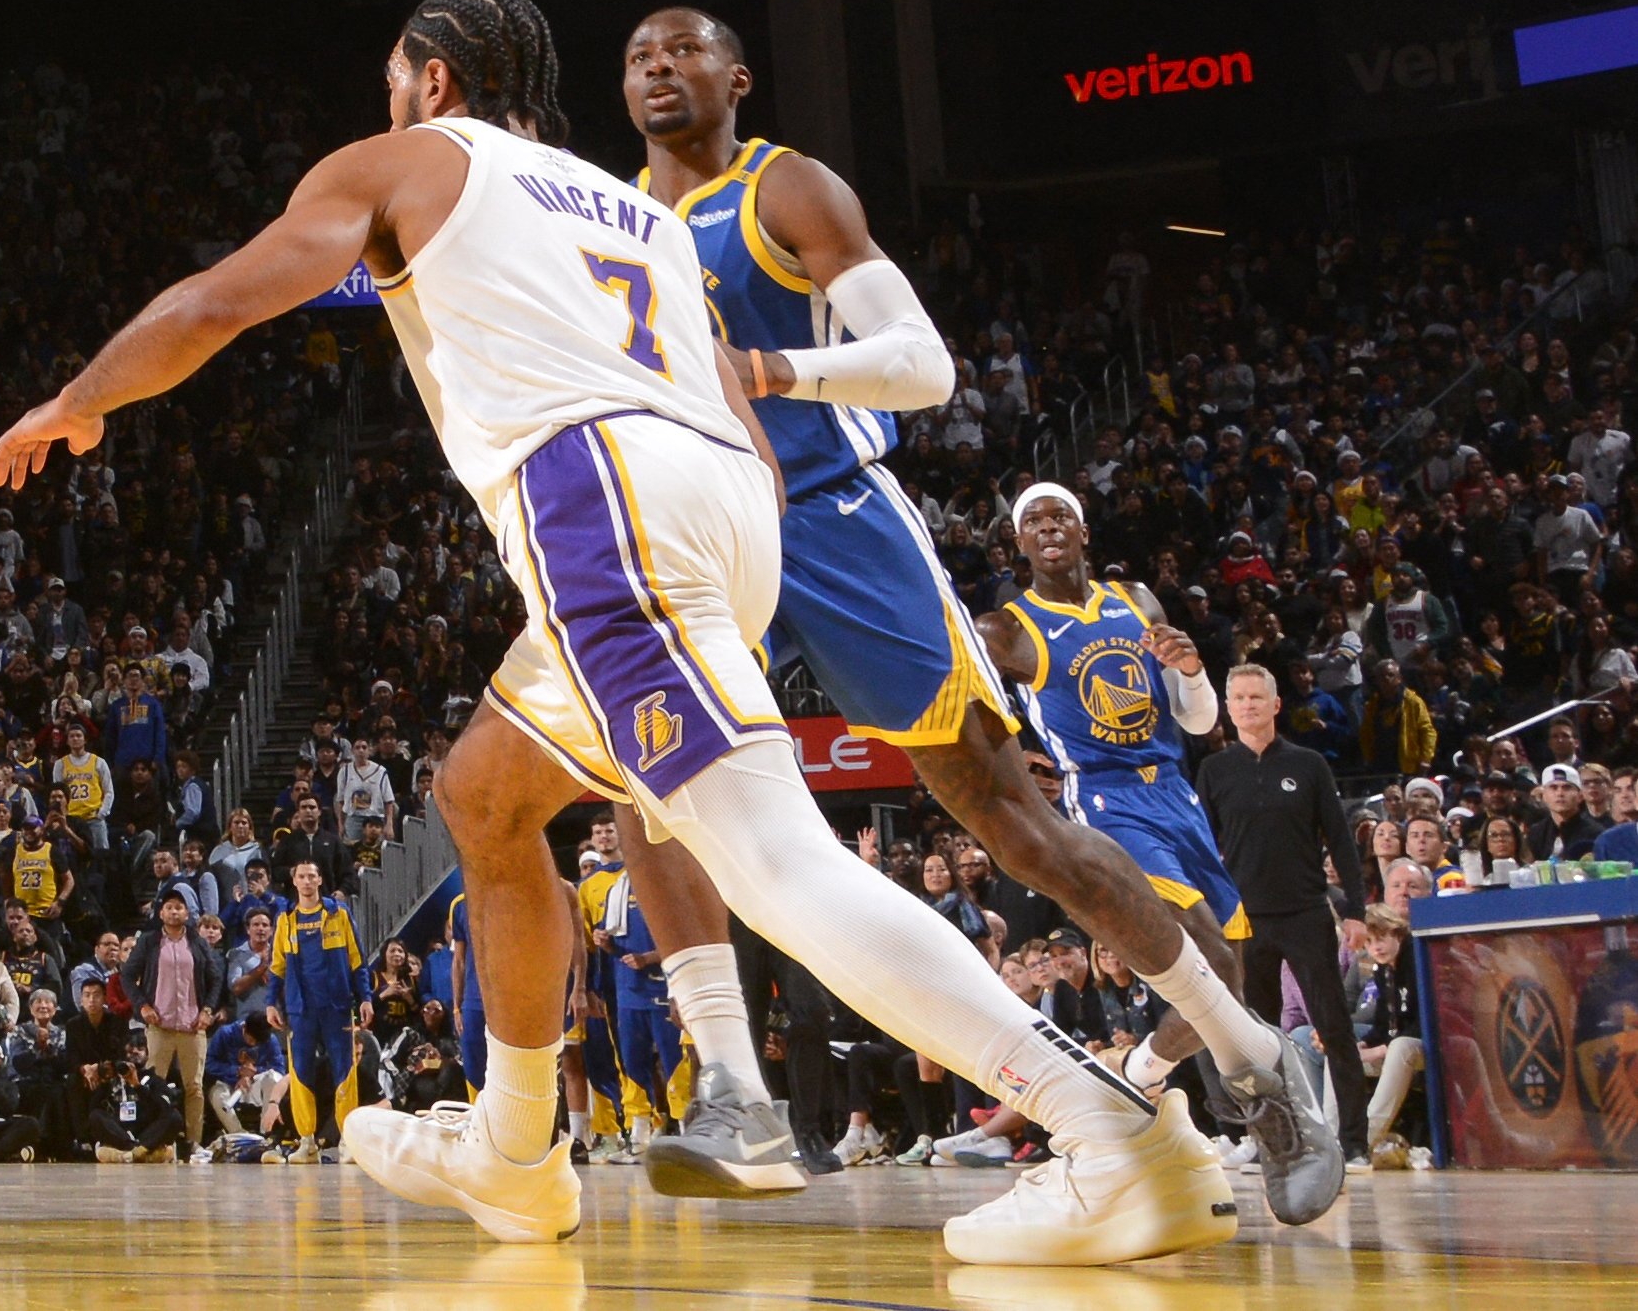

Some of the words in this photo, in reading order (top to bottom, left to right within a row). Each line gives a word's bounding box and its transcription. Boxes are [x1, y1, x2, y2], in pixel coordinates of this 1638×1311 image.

[1064, 50, 1253, 104] verizon
[513, 172, 661, 246] VINCENT
[689, 208, 736, 229] Rakuten
[578, 246, 676, 384] 7
[1068, 639, 1106, 677] GOLDEN
[20, 871, 42, 889] 23
